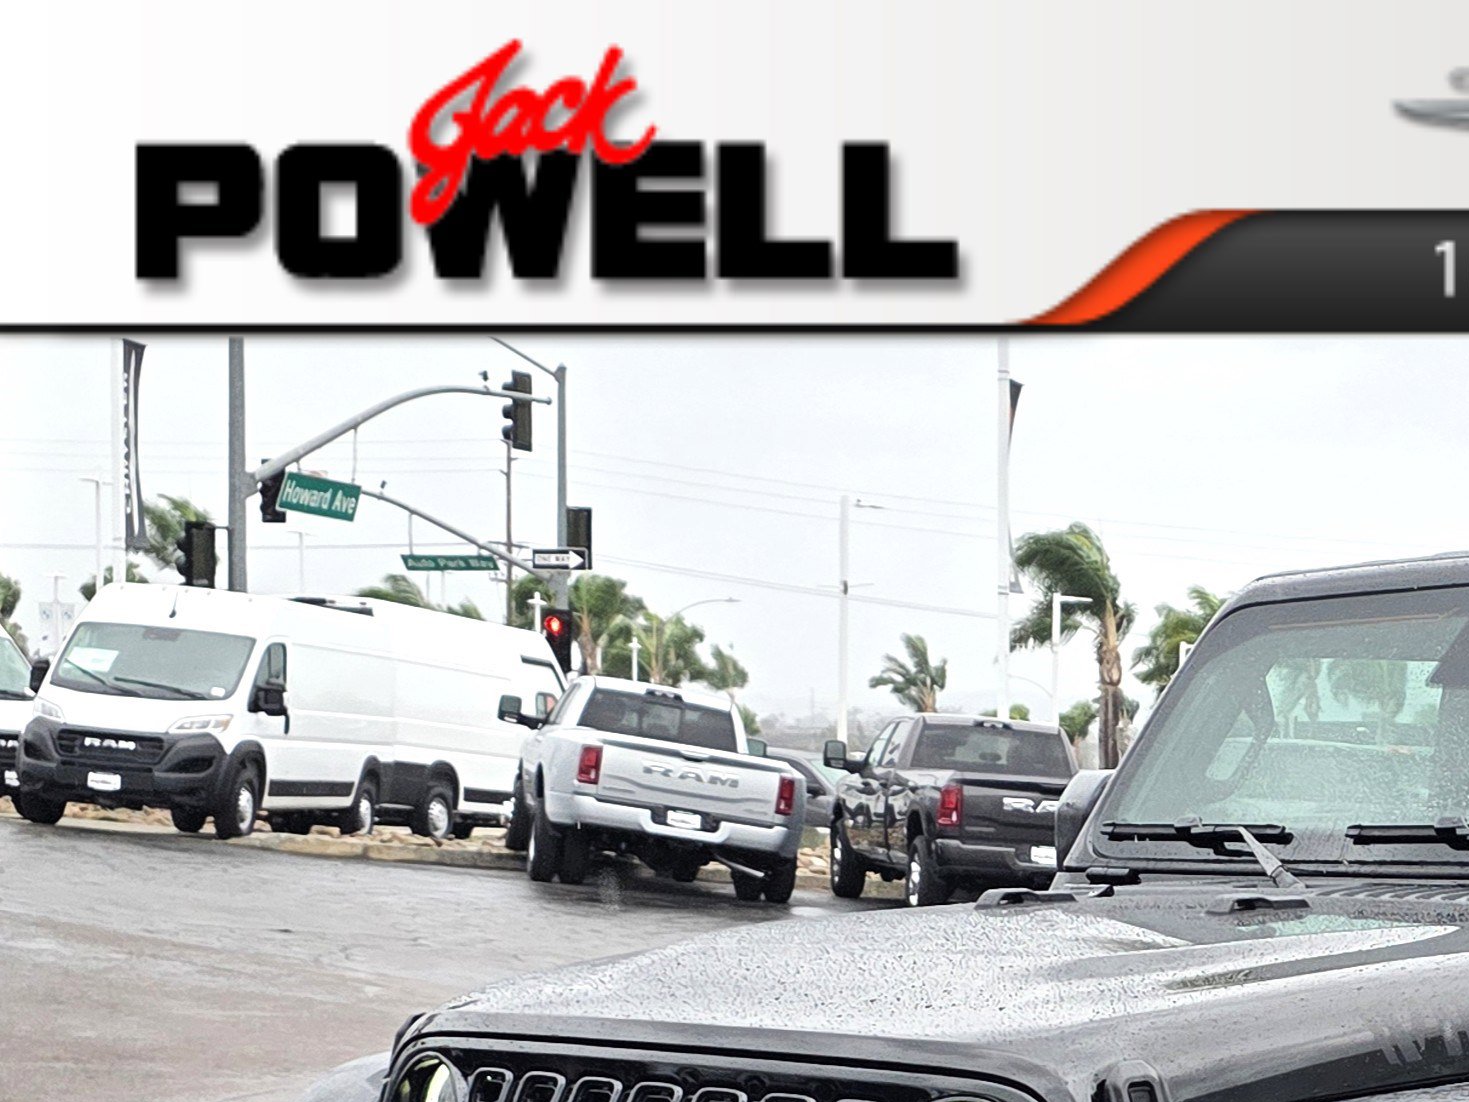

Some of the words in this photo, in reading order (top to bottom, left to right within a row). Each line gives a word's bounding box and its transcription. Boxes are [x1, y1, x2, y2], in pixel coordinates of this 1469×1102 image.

[282, 479, 333, 510] Howard
[331, 489, 357, 514] Ave
[83, 736, 136, 751] RAM
[642, 762, 740, 789] RAM
[1002, 796, 1060, 814] RA
